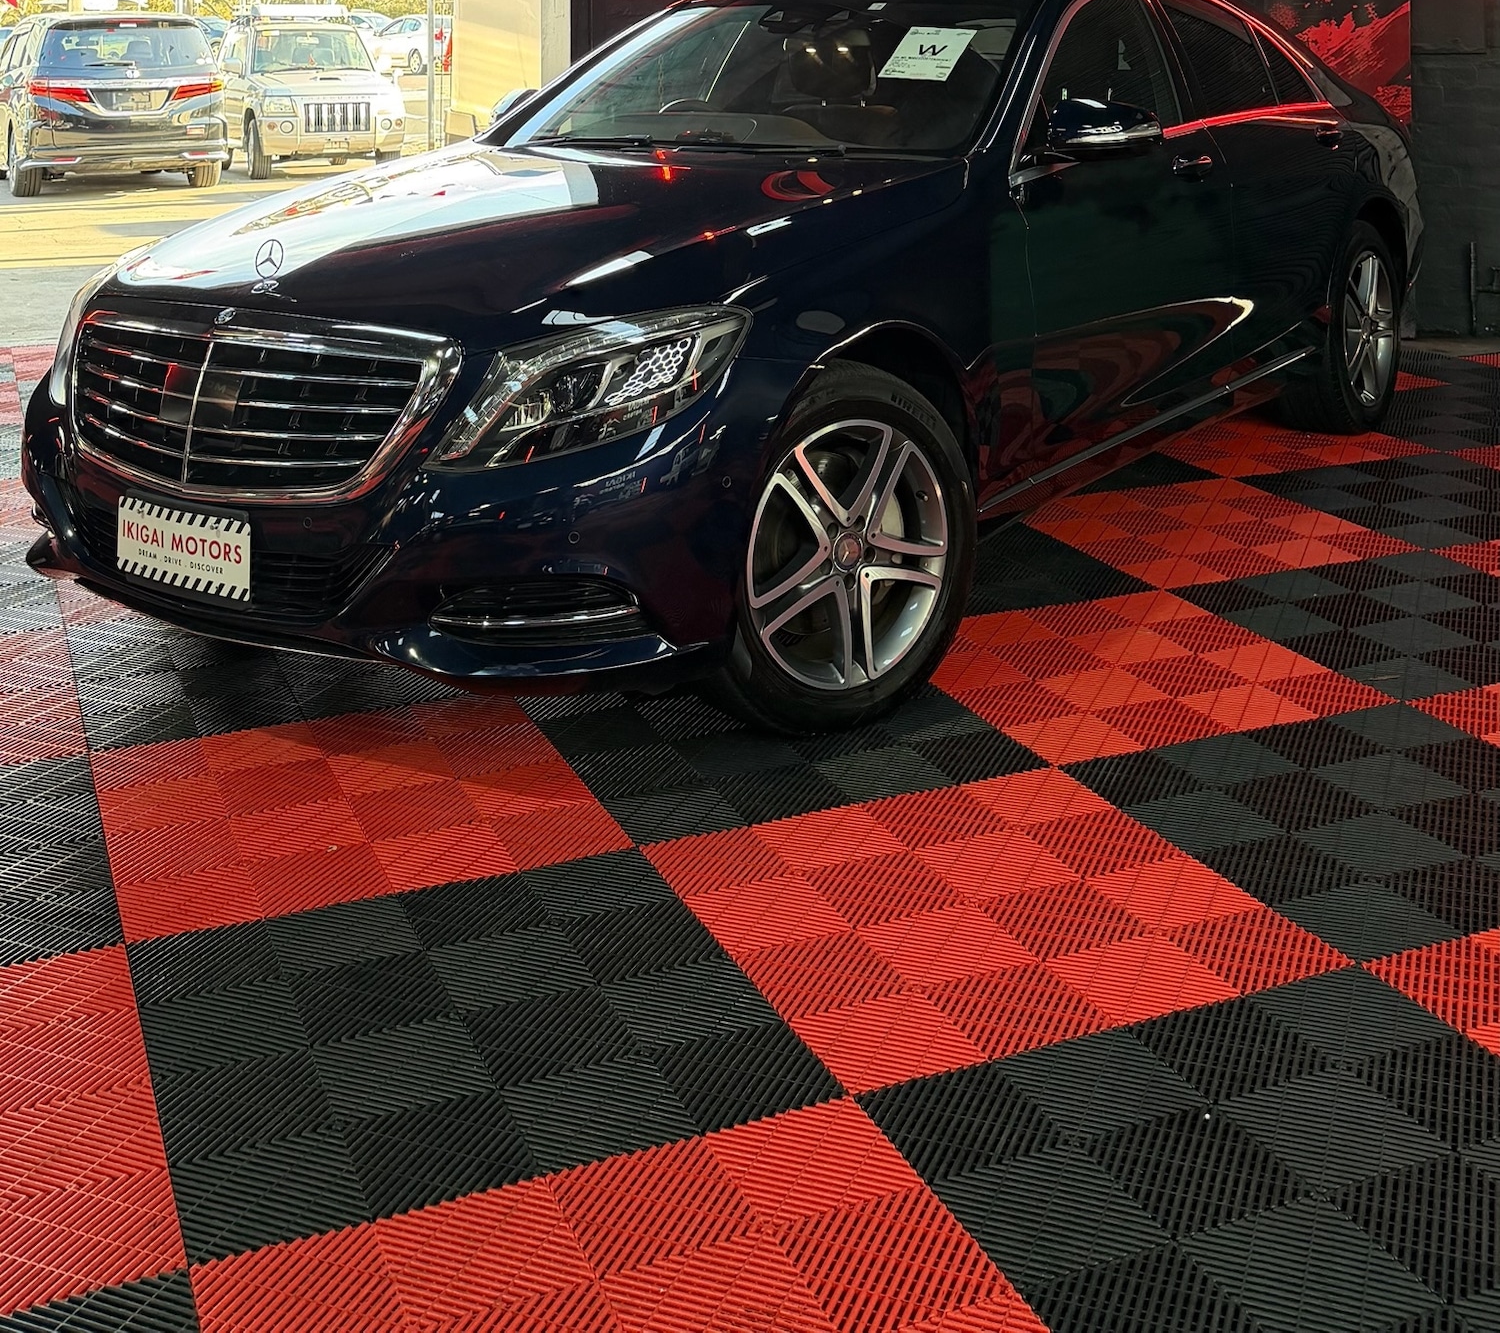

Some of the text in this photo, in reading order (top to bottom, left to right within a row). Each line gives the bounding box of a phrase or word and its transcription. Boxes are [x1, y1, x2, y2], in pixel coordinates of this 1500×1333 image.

[122, 519, 242, 565] IKIGAI MOTORS
[138, 548, 224, 575] DREAM DRIVE DISCOVER
